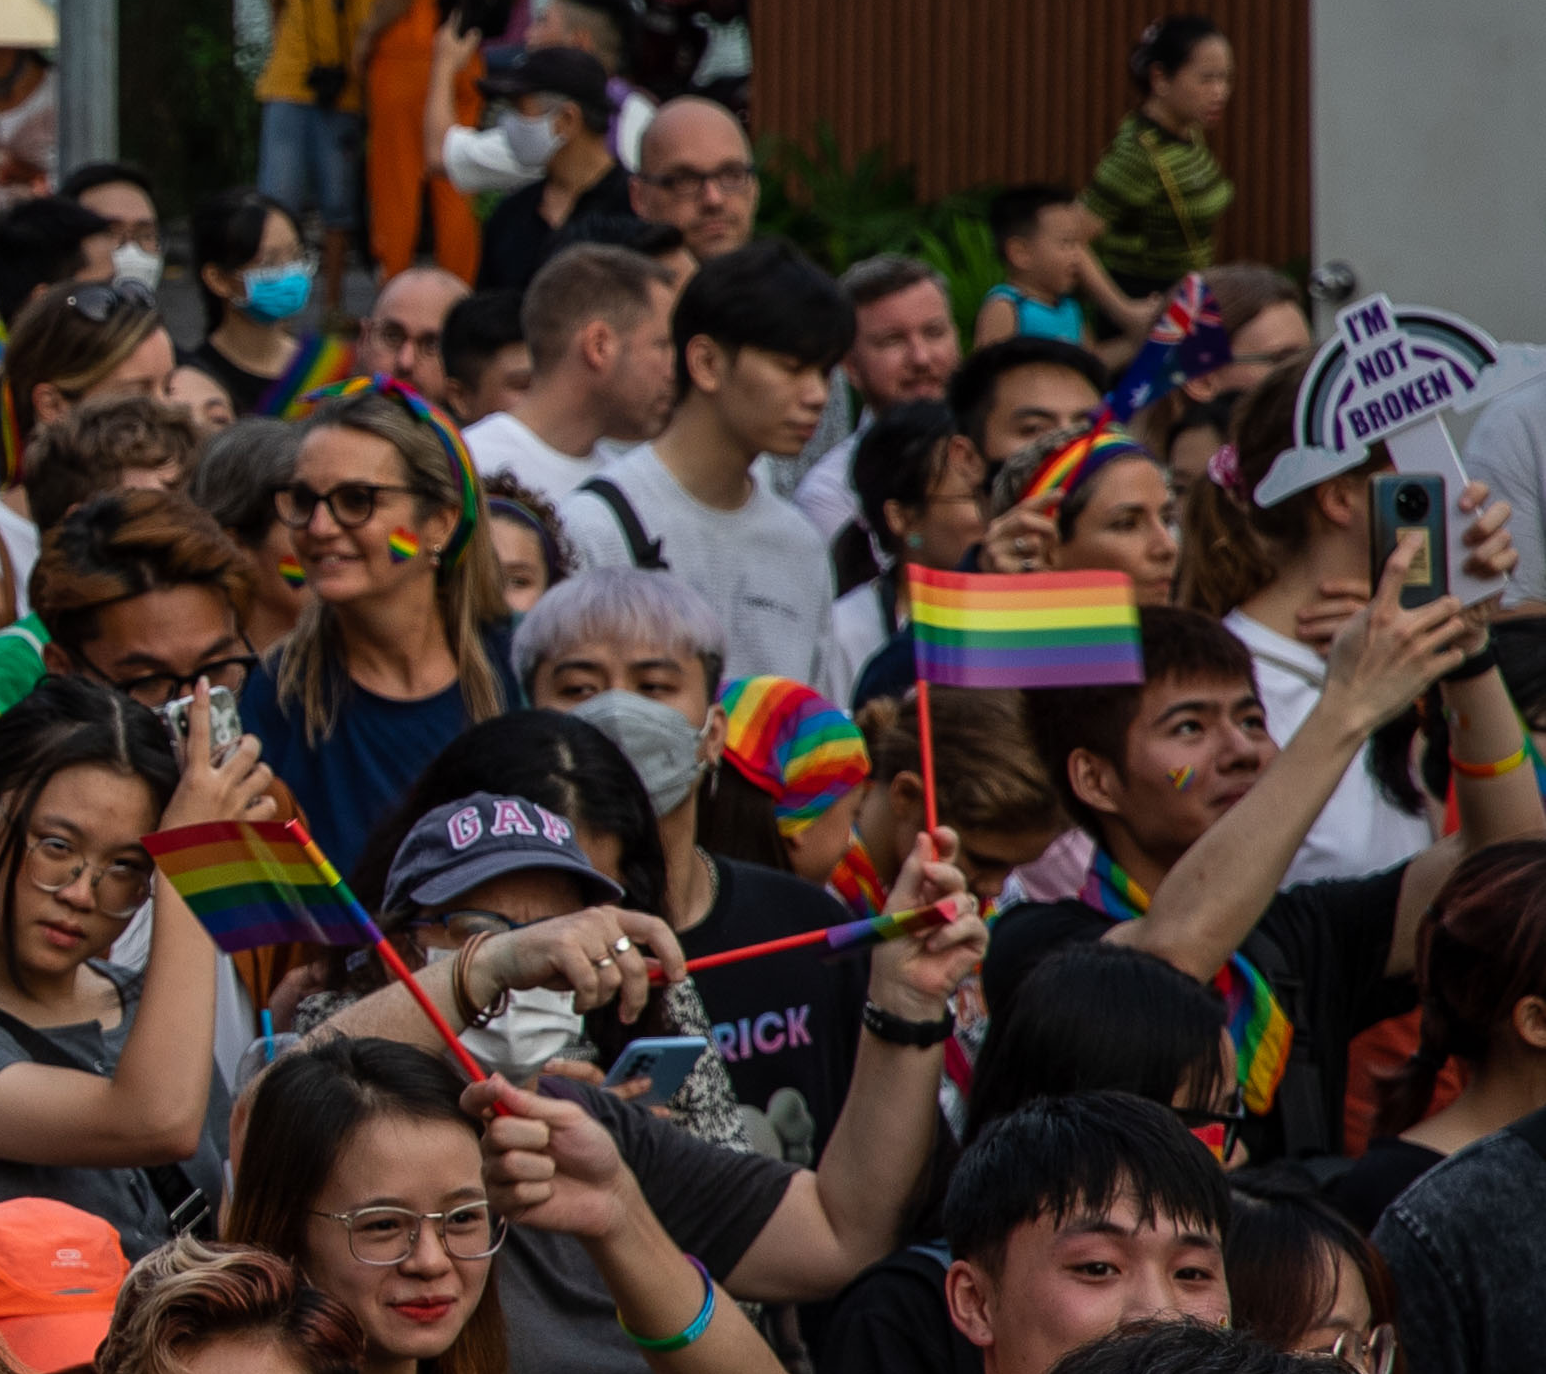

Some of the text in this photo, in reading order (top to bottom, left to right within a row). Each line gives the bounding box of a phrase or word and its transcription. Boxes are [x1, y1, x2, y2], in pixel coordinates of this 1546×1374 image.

[1345, 304, 1388, 343] I'M
[1356, 340, 1408, 387] NOT
[1348, 369, 1452, 438] BROKEN
[447, 800, 571, 850] GAP
